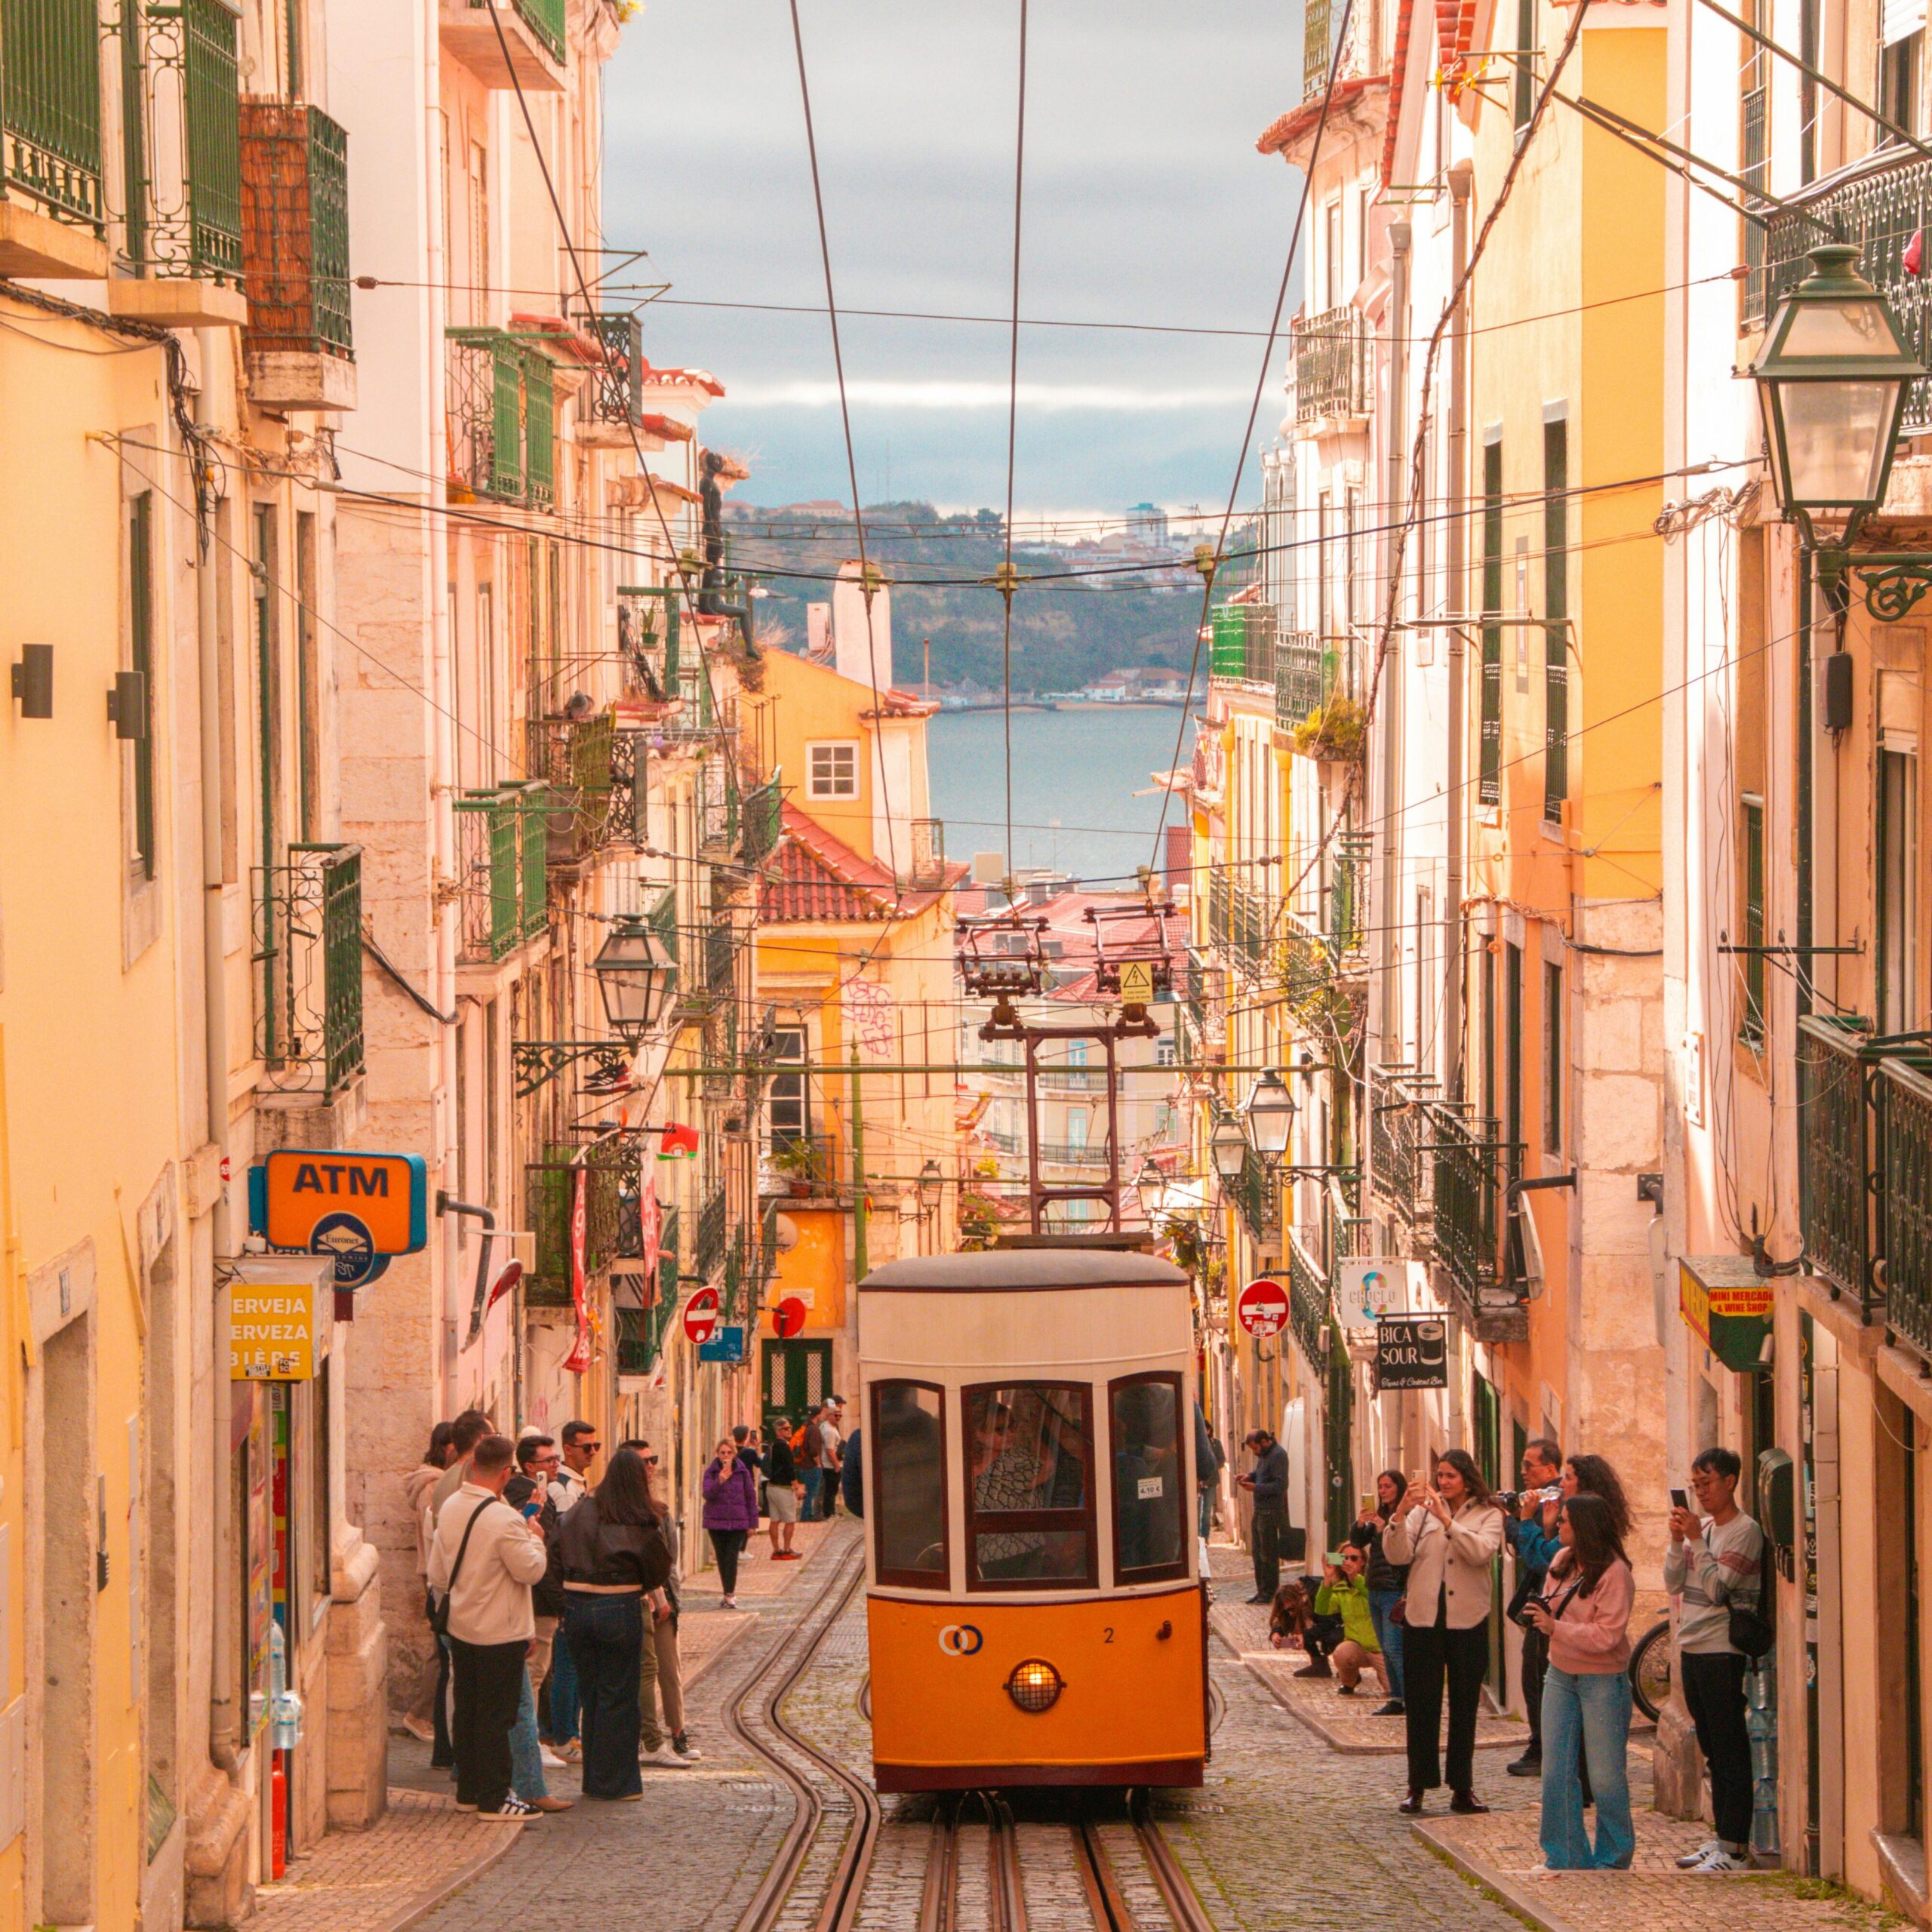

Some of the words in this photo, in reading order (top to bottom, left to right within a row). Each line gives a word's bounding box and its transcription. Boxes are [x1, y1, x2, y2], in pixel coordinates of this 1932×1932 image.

[293, 1163, 389, 1198] ATM
[325, 1234, 359, 1244] Euronet
[1349, 1290, 1395, 1304] CHOCLO
[1710, 1291, 1730, 1301] MINI
[1733, 1291, 1774, 1301] MERCADO
[232, 1298, 306, 1315] ERVEJA
[1724, 1303, 1745, 1312] WINE
[1747, 1303, 1767, 1312] SHOP
[231, 1324, 309, 1340] ERVEZA
[1380, 1327, 1412, 1343] BICA
[1380, 1347, 1418, 1365] SOUR
[1381, 1377, 1399, 1388] Tapas
[1406, 1377, 1430, 1387] Cocktail
[1430, 1376, 1443, 1386] Bar
[1103, 1627, 1115, 1644] 2
